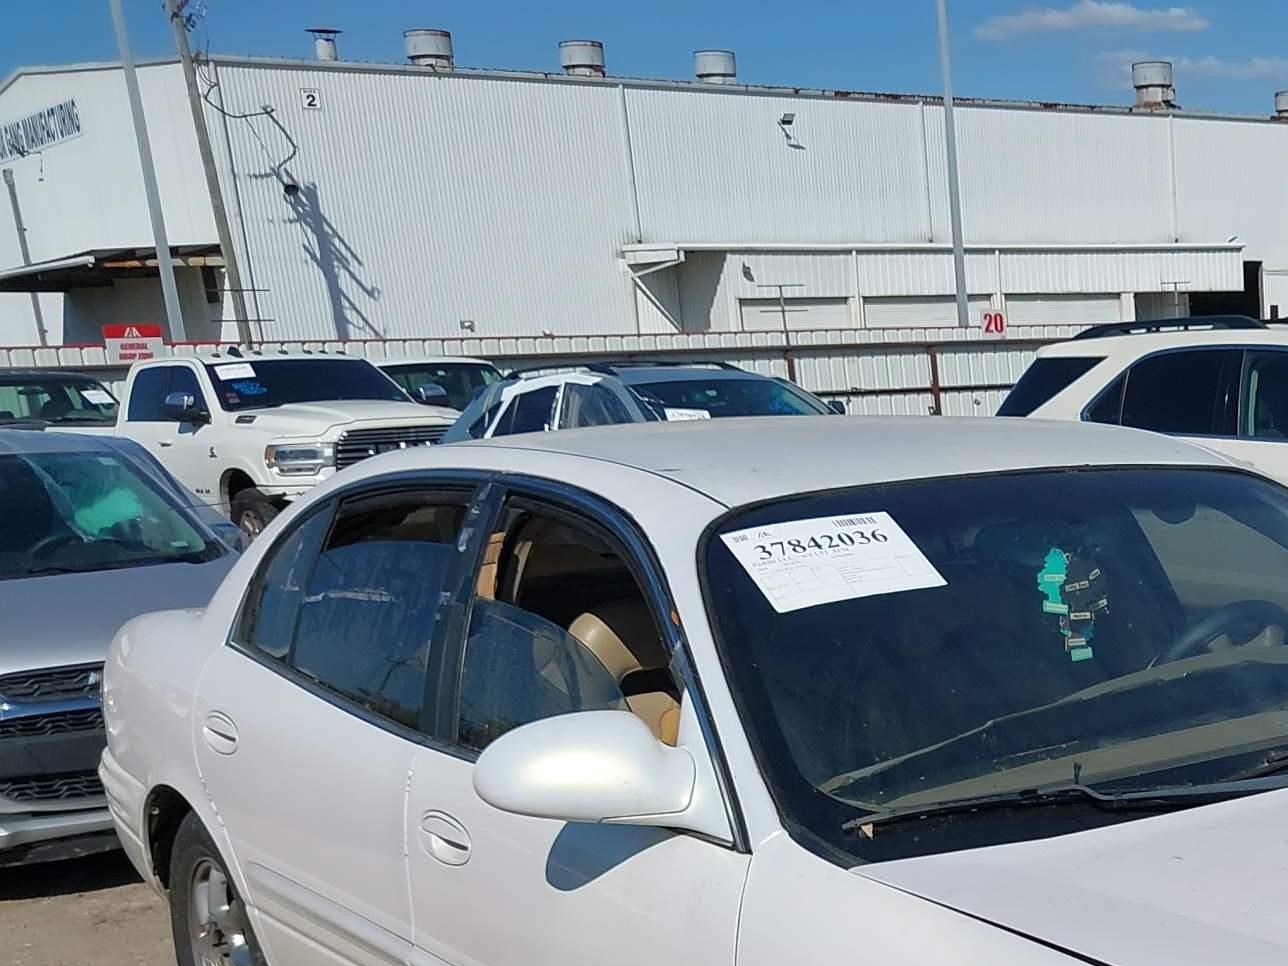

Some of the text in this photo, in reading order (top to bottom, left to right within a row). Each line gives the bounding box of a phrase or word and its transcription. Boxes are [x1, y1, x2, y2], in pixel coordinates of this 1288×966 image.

[306, 94, 317, 107] 2
[22, 99, 80, 150] MANUFACTURING
[983, 313, 1004, 334] 20
[753, 528, 888, 560] 37842036
